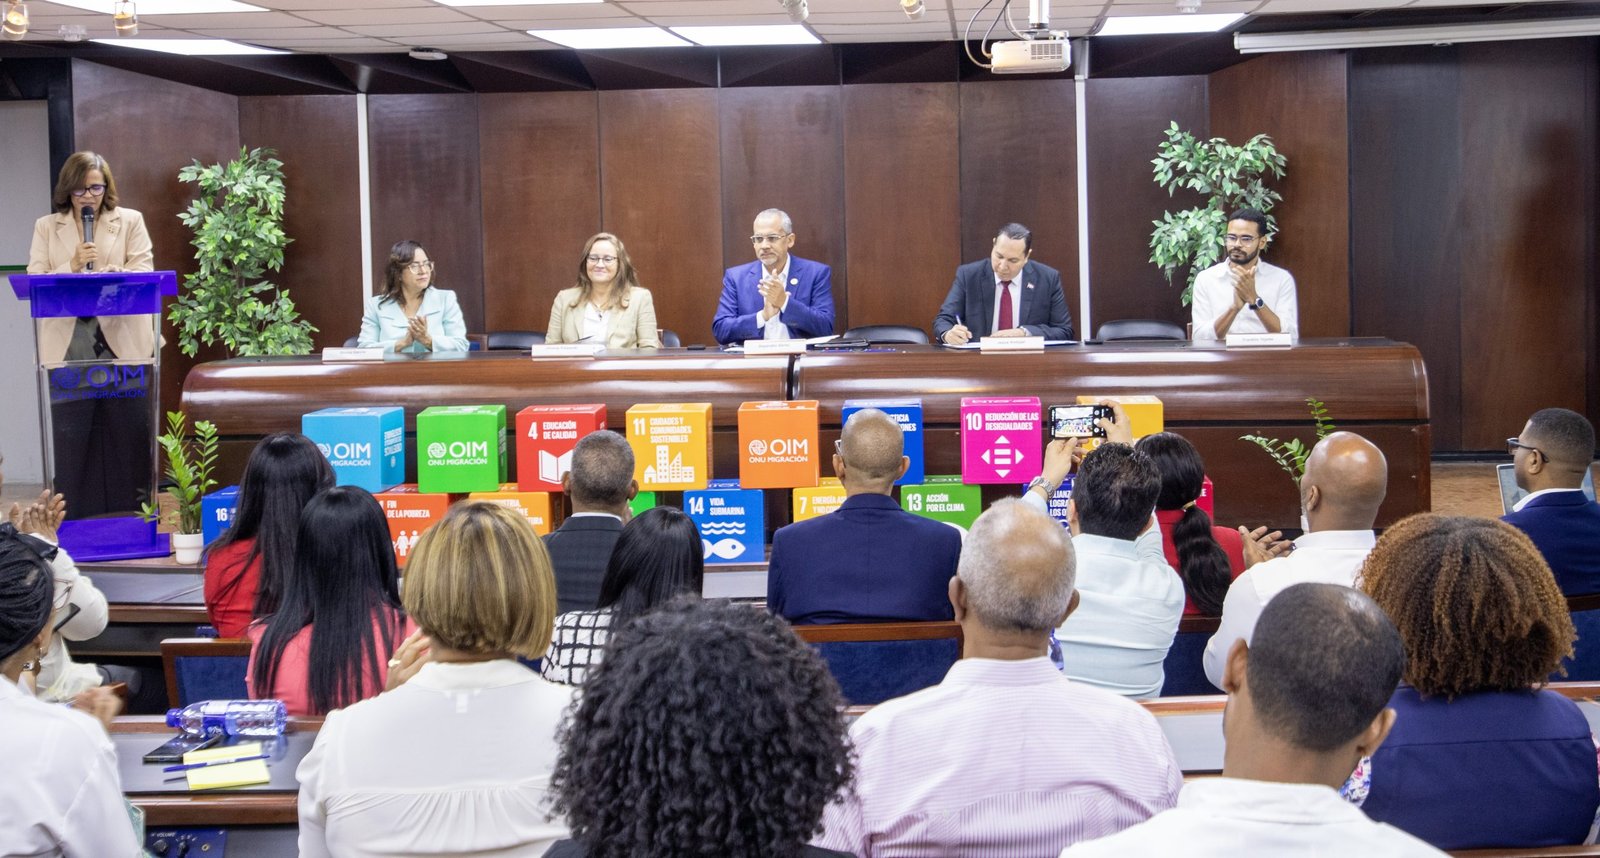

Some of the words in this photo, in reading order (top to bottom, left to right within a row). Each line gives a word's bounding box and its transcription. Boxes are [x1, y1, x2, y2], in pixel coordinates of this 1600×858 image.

[86, 365, 145, 388] OIM
[965, 412, 982, 431] 10
[985, 411, 1018, 421] REDUCCIÓN
[1019, 412, 1027, 421] DE
[1027, 412, 1039, 421] LAS
[542, 419, 577, 430] EDUCACIÓN
[633, 417, 646, 436] 11
[985, 421, 1033, 431] DESIGUALDADES
[527, 421, 538, 440] 4
[543, 430, 551, 440] DE
[551, 430, 577, 440] CALIDAD
[333, 442, 371, 460] OIM
[448, 440, 488, 458] OIM
[770, 438, 809, 455] OIM
[331, 459, 371, 467] MIGRACIÓN
[427, 458, 446, 467] ONU
[446, 457, 488, 466] MIGRACIÓN
[748, 456, 766, 464] ONU
[767, 455, 809, 463] MIGRACIÓN
[709, 497, 725, 506] VIDA
[906, 493, 922, 511] 13
[926, 492, 949, 503] ACCIÓN
[386, 500, 397, 509] FIN
[688, 496, 704, 515] 14
[799, 496, 808, 515] 7
[926, 503, 938, 512] POR
[938, 503, 946, 512] EL
[946, 503, 965, 512] CLIMA
[215, 507, 228, 522] 16
[386, 509, 395, 518] DE
[395, 509, 404, 518] LA
[403, 509, 431, 518] POBREZA
[709, 506, 745, 516] SUBMARINA
[1049, 508, 1061, 517] LOS
